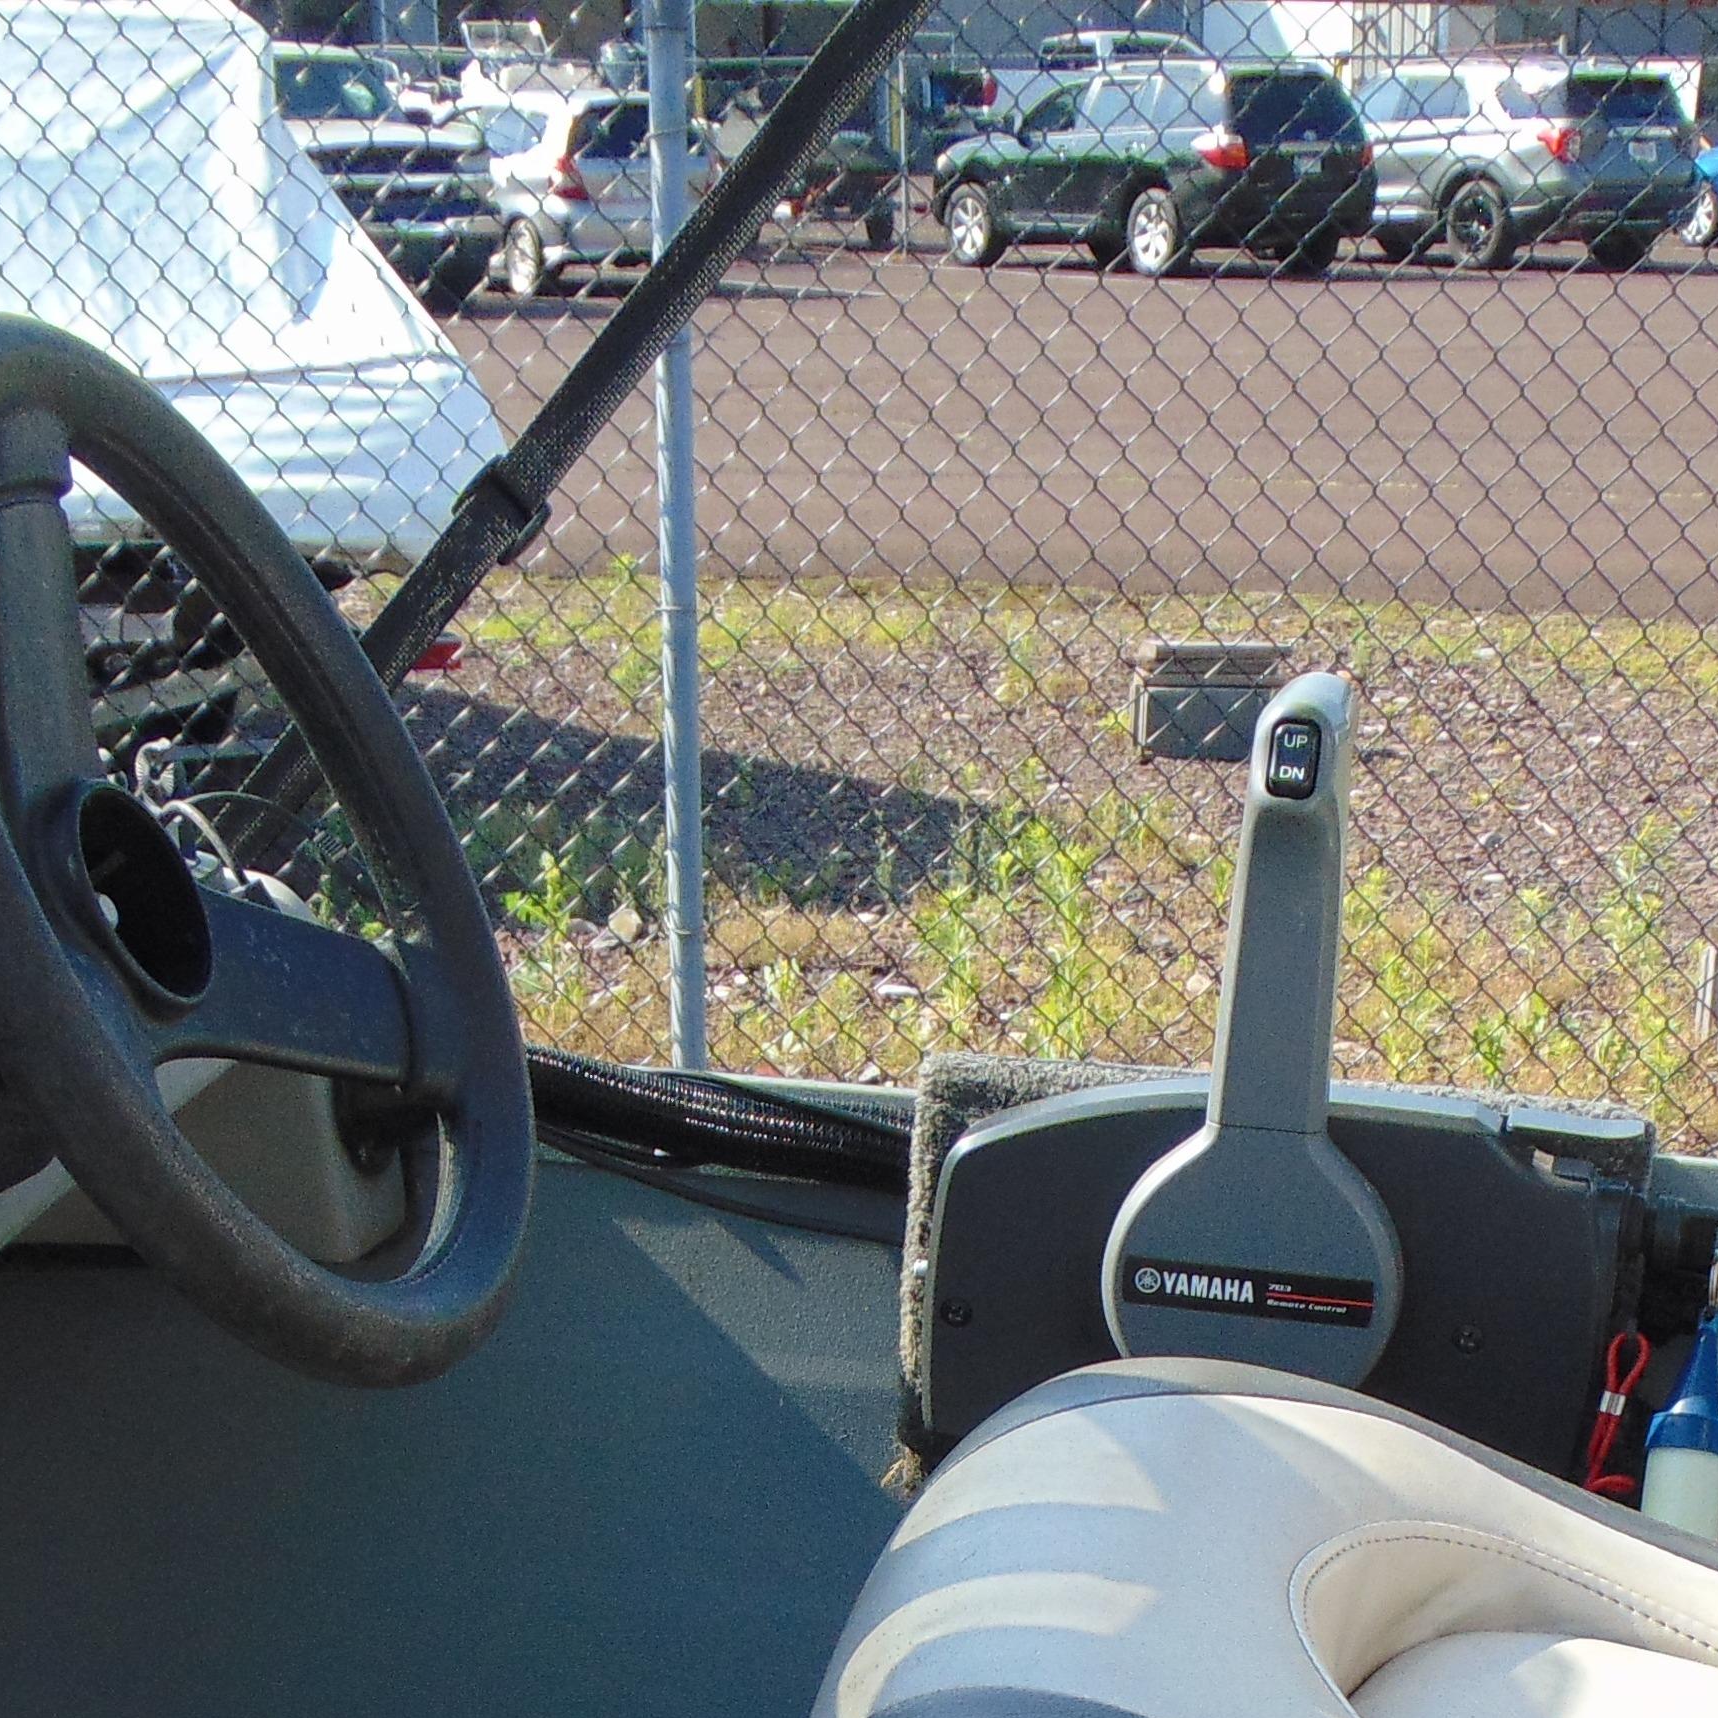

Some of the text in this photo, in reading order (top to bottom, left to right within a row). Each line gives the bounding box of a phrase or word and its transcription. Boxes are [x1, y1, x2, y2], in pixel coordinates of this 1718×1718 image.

[1284, 733, 1308, 749] UP
[1279, 765, 1305, 780] DN
[1162, 1271, 1254, 1304] YAMAHA
[1266, 1298, 1347, 1314] Remote Control
